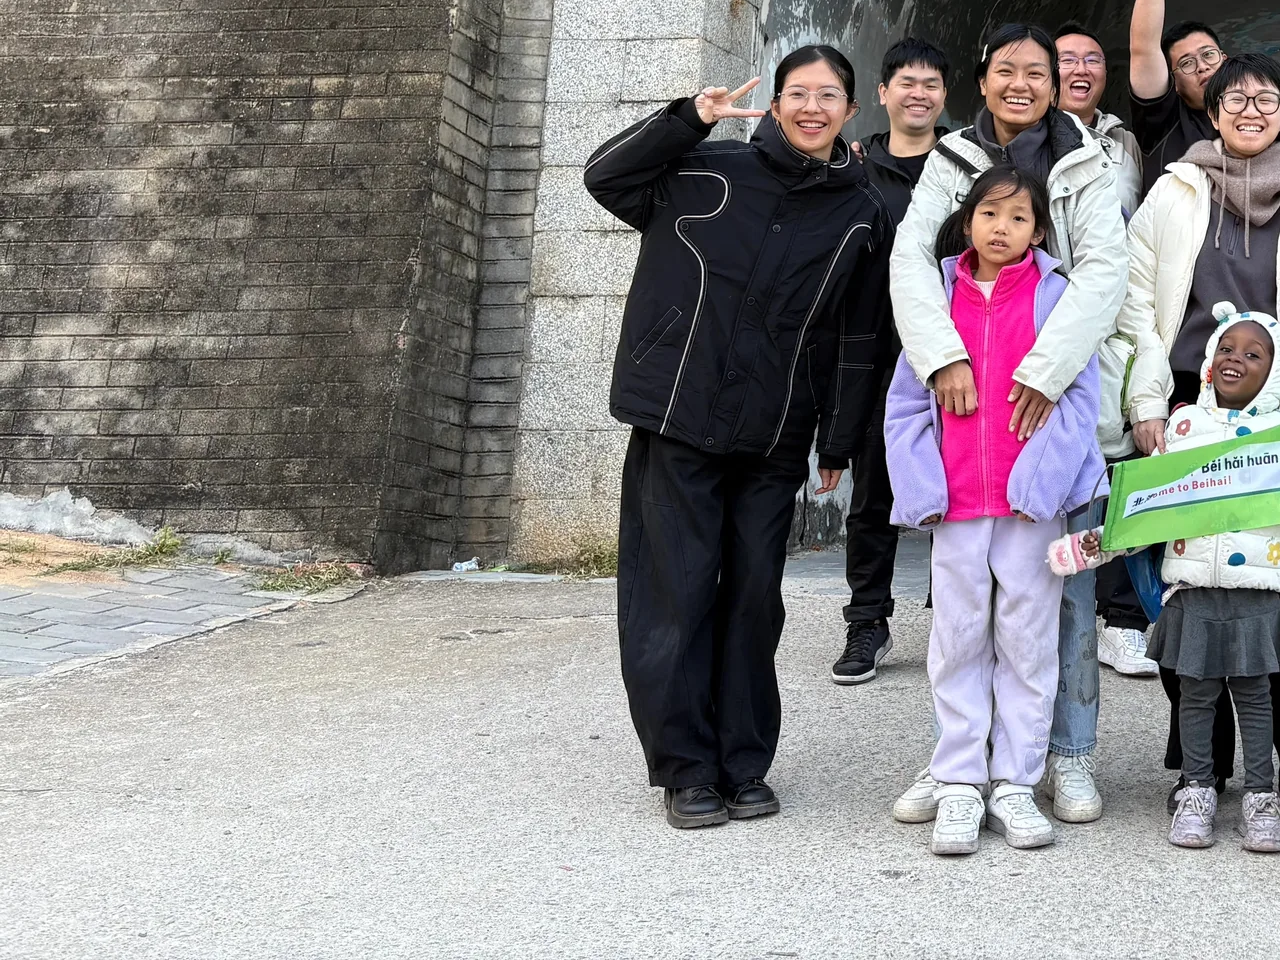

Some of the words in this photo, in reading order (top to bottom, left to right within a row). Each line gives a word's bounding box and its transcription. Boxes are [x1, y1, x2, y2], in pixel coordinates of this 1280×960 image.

[1247, 451, 1279, 467] huān
[1177, 483, 1189, 492] to
[1191, 476, 1232, 491] Beihai!
